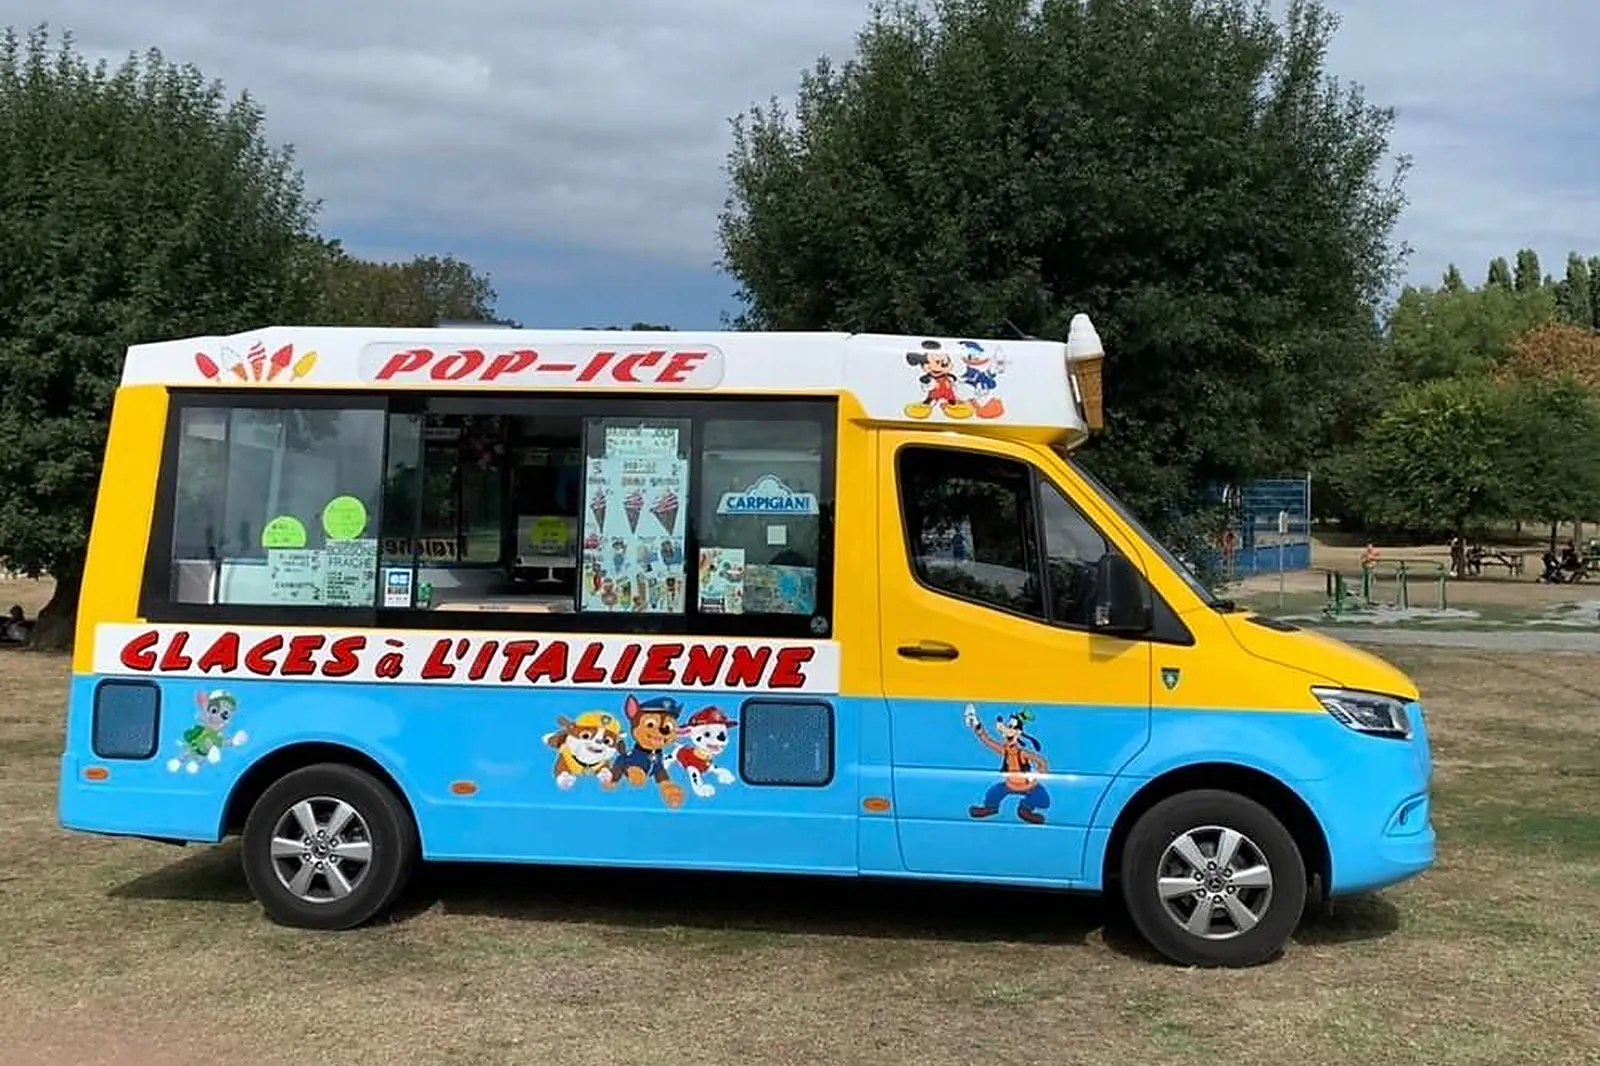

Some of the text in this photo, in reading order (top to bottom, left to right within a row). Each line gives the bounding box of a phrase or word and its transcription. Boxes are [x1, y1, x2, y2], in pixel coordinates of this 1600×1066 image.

[375, 349, 707, 382] POP-ICE
[727, 497, 810, 509] CARPIGIANI
[120, 630, 814, 687] GLACES à L'ITALIENNE
